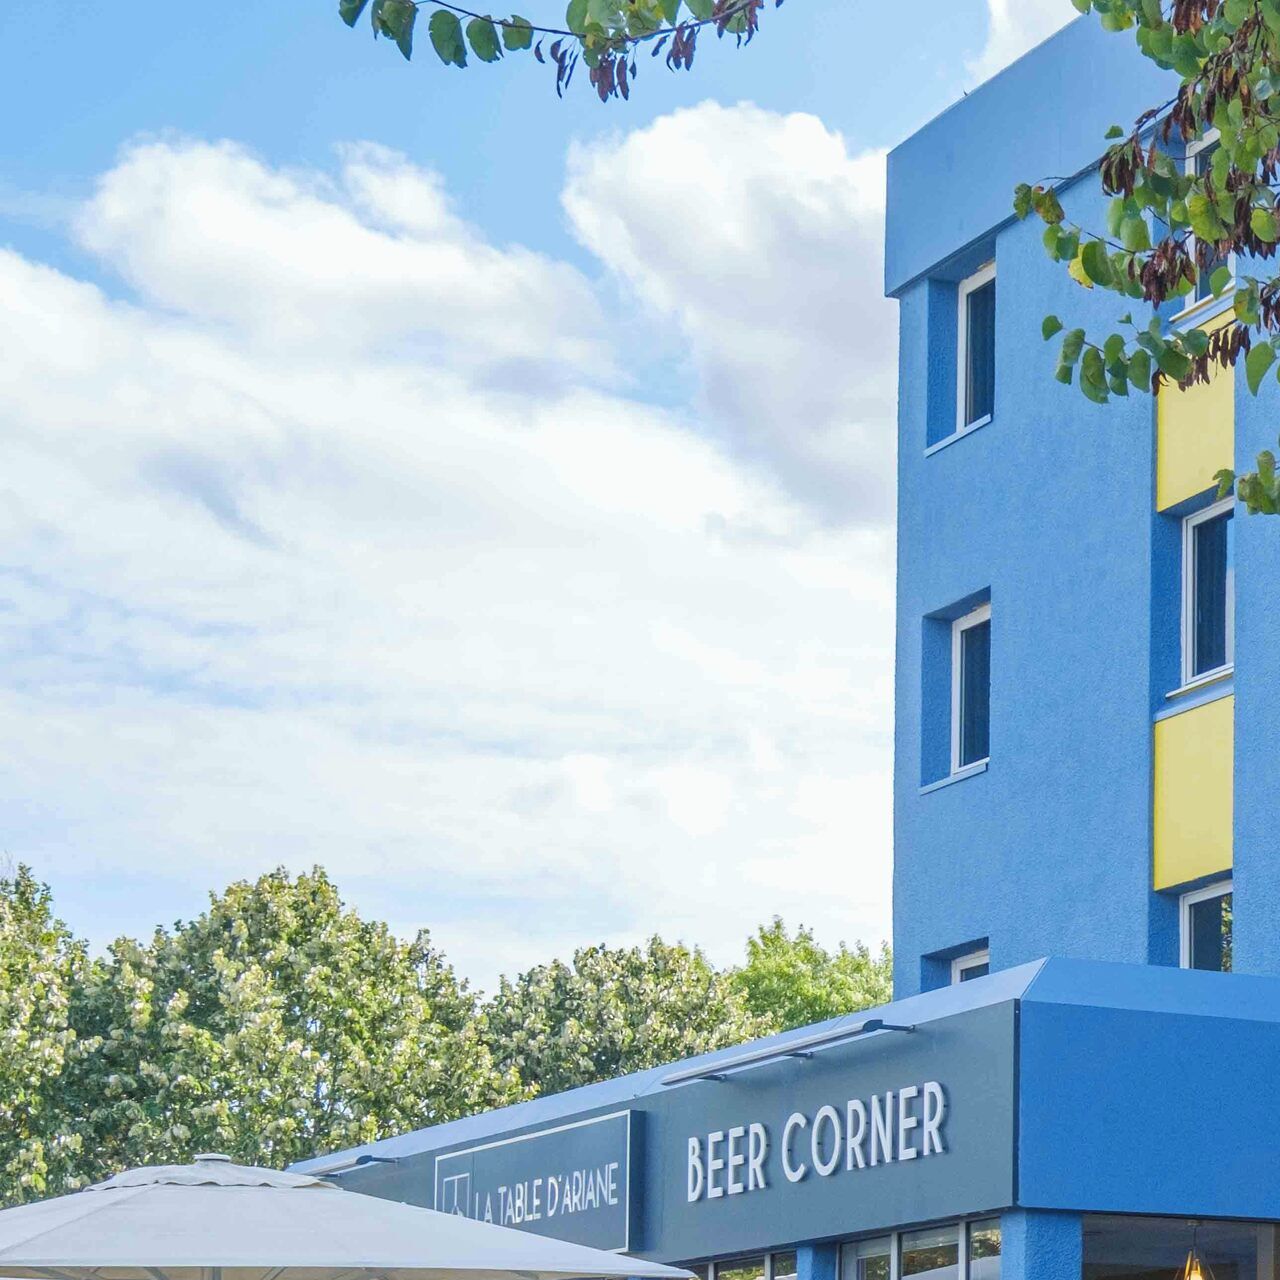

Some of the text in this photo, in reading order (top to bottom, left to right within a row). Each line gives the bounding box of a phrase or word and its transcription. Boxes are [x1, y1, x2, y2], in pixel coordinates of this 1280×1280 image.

[687, 1081, 944, 1203] BEER CORNER
[497, 1178, 543, 1225] TABLE
[547, 1162, 619, 1217] D'ARIANE
